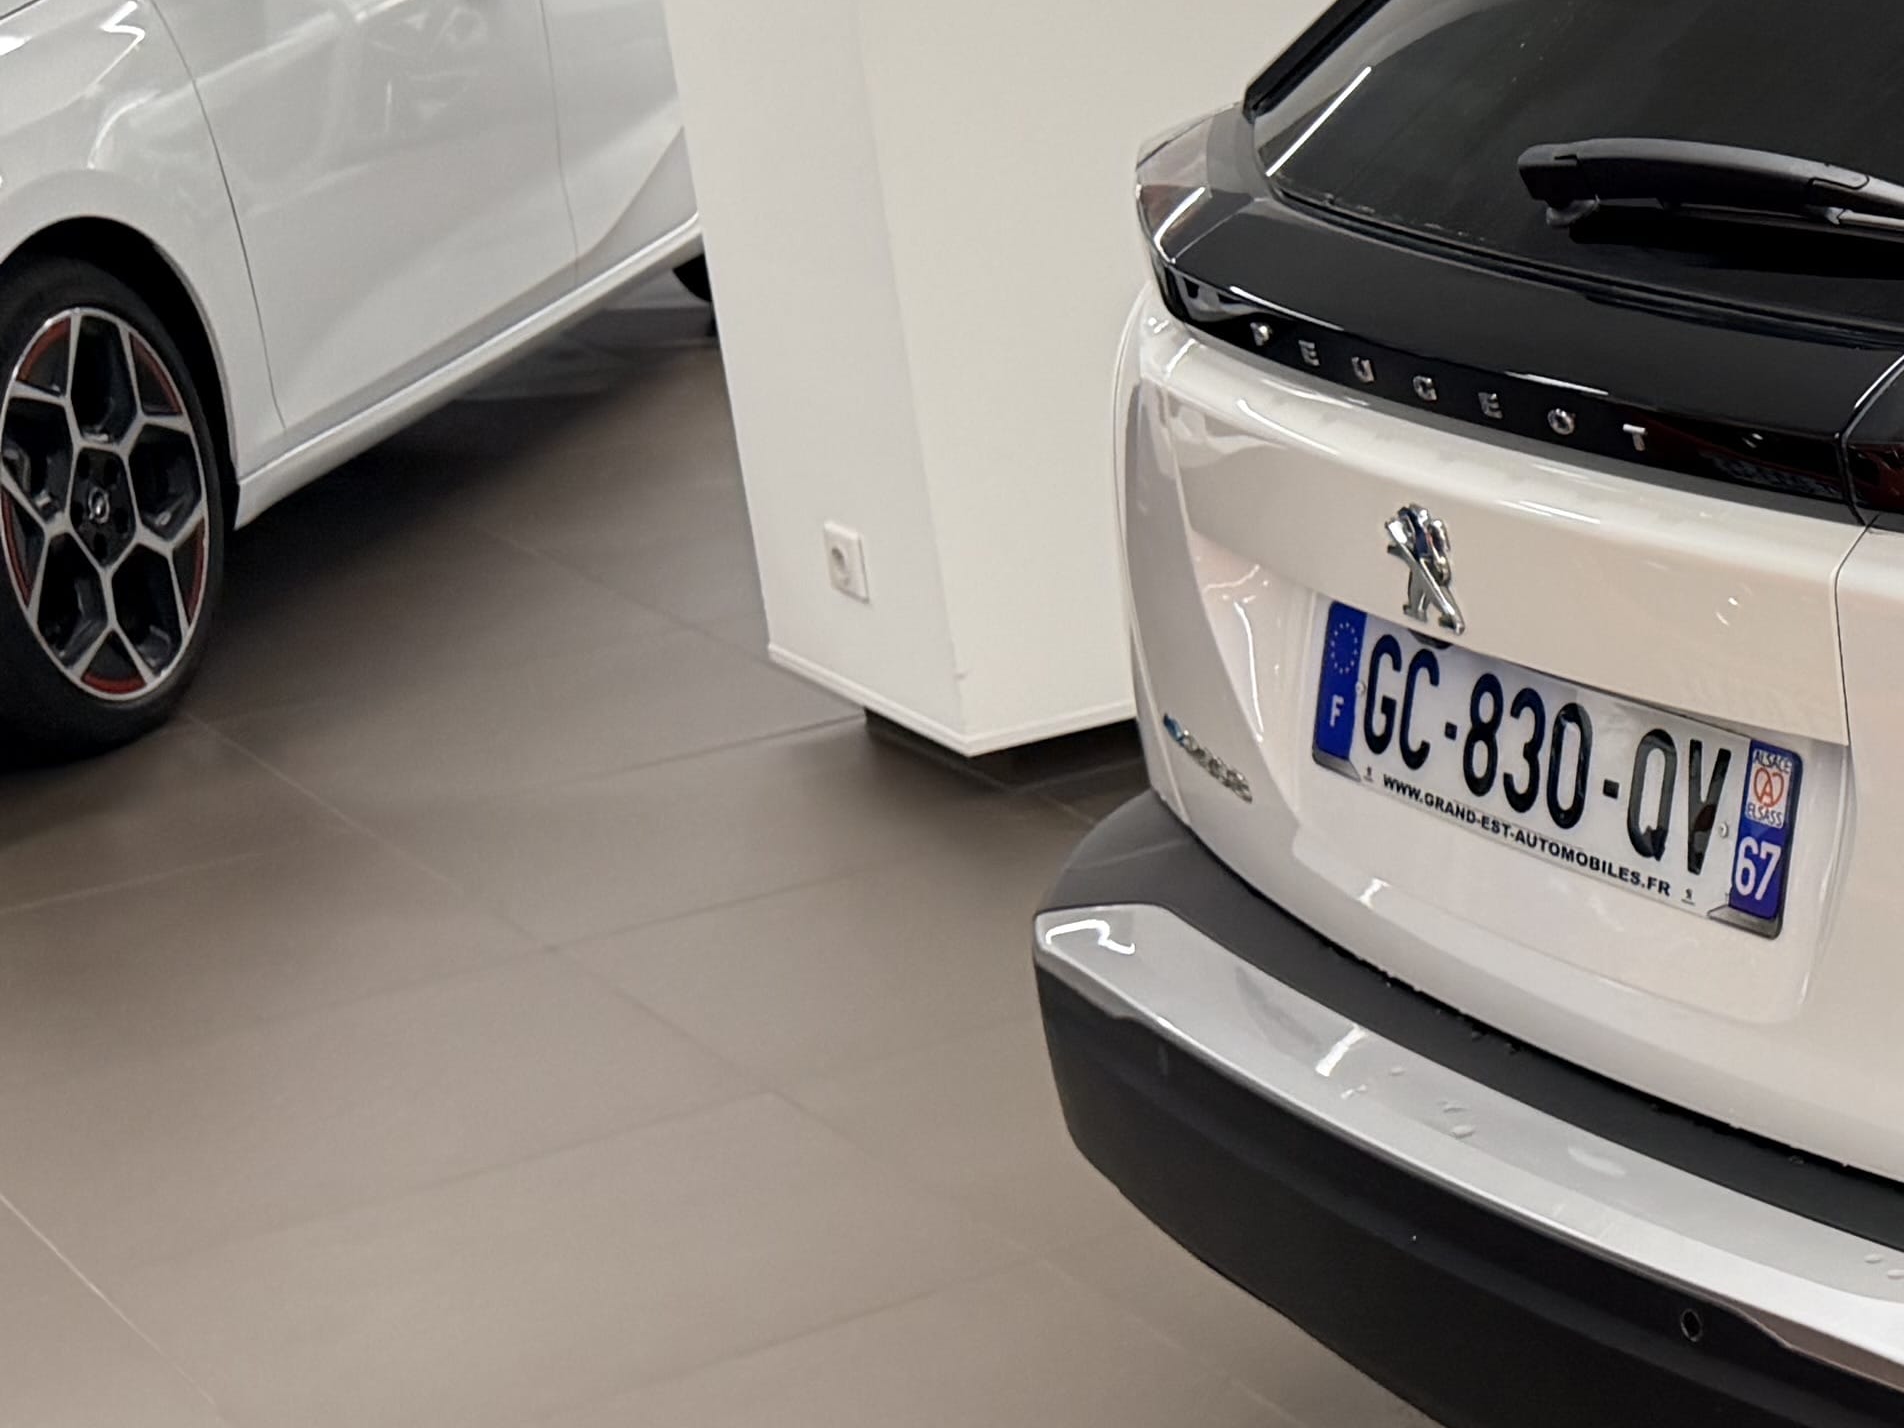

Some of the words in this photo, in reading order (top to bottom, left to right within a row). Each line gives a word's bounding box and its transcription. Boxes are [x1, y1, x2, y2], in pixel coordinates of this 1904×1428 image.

[1249, 320, 1648, 452] PEUGEOT
[1330, 694, 1345, 728] F
[1364, 634, 1732, 876] GC-830-QV
[1754, 749, 1793, 774] ALSACE
[1382, 773, 1671, 897] WWW.GRAND-EST-AUTOMOBILES.FR
[1746, 802, 1784, 827] ELSASS
[1735, 835, 1782, 901] 67
